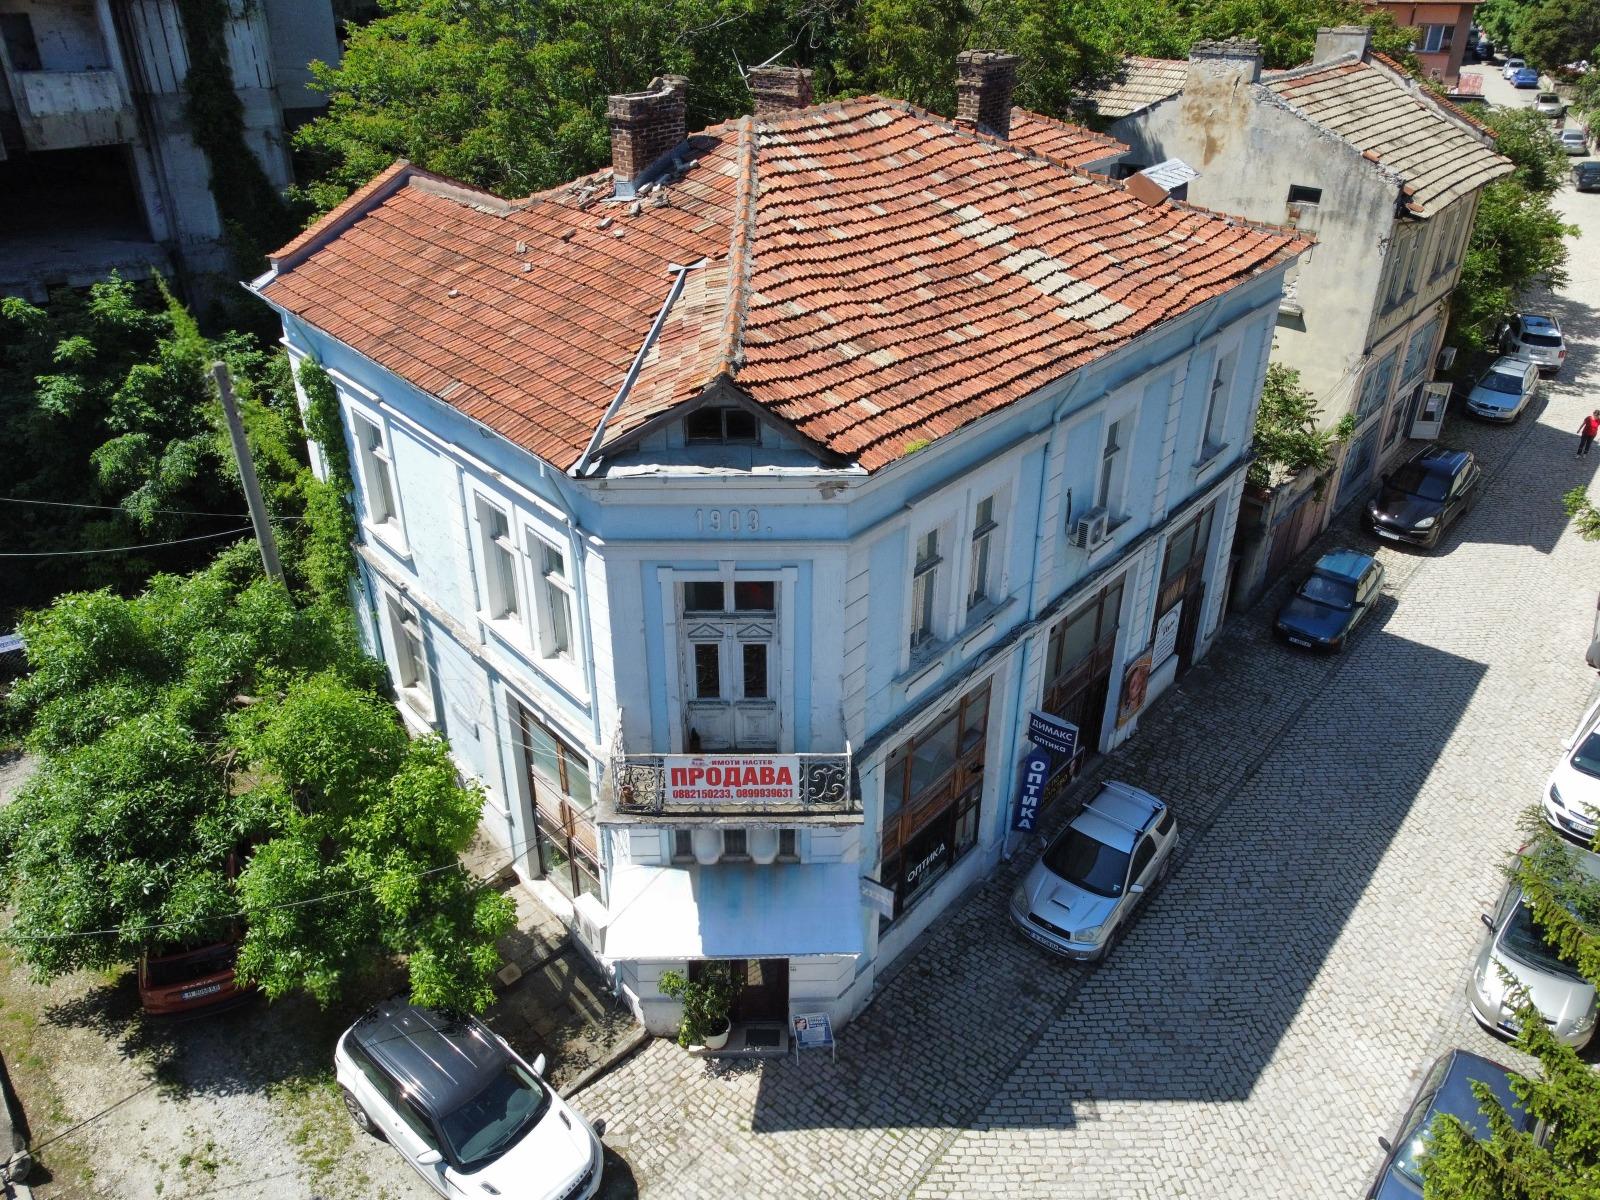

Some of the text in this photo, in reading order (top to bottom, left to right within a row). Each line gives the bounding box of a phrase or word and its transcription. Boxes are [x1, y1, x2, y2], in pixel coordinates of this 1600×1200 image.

[1030, 718, 1073, 742] ДИМАКС
[671, 767, 793, 788] ПРОДАВА
[1017, 760, 1047, 830] ОПТИКА
[907, 842, 946, 882] ОПТИКА
